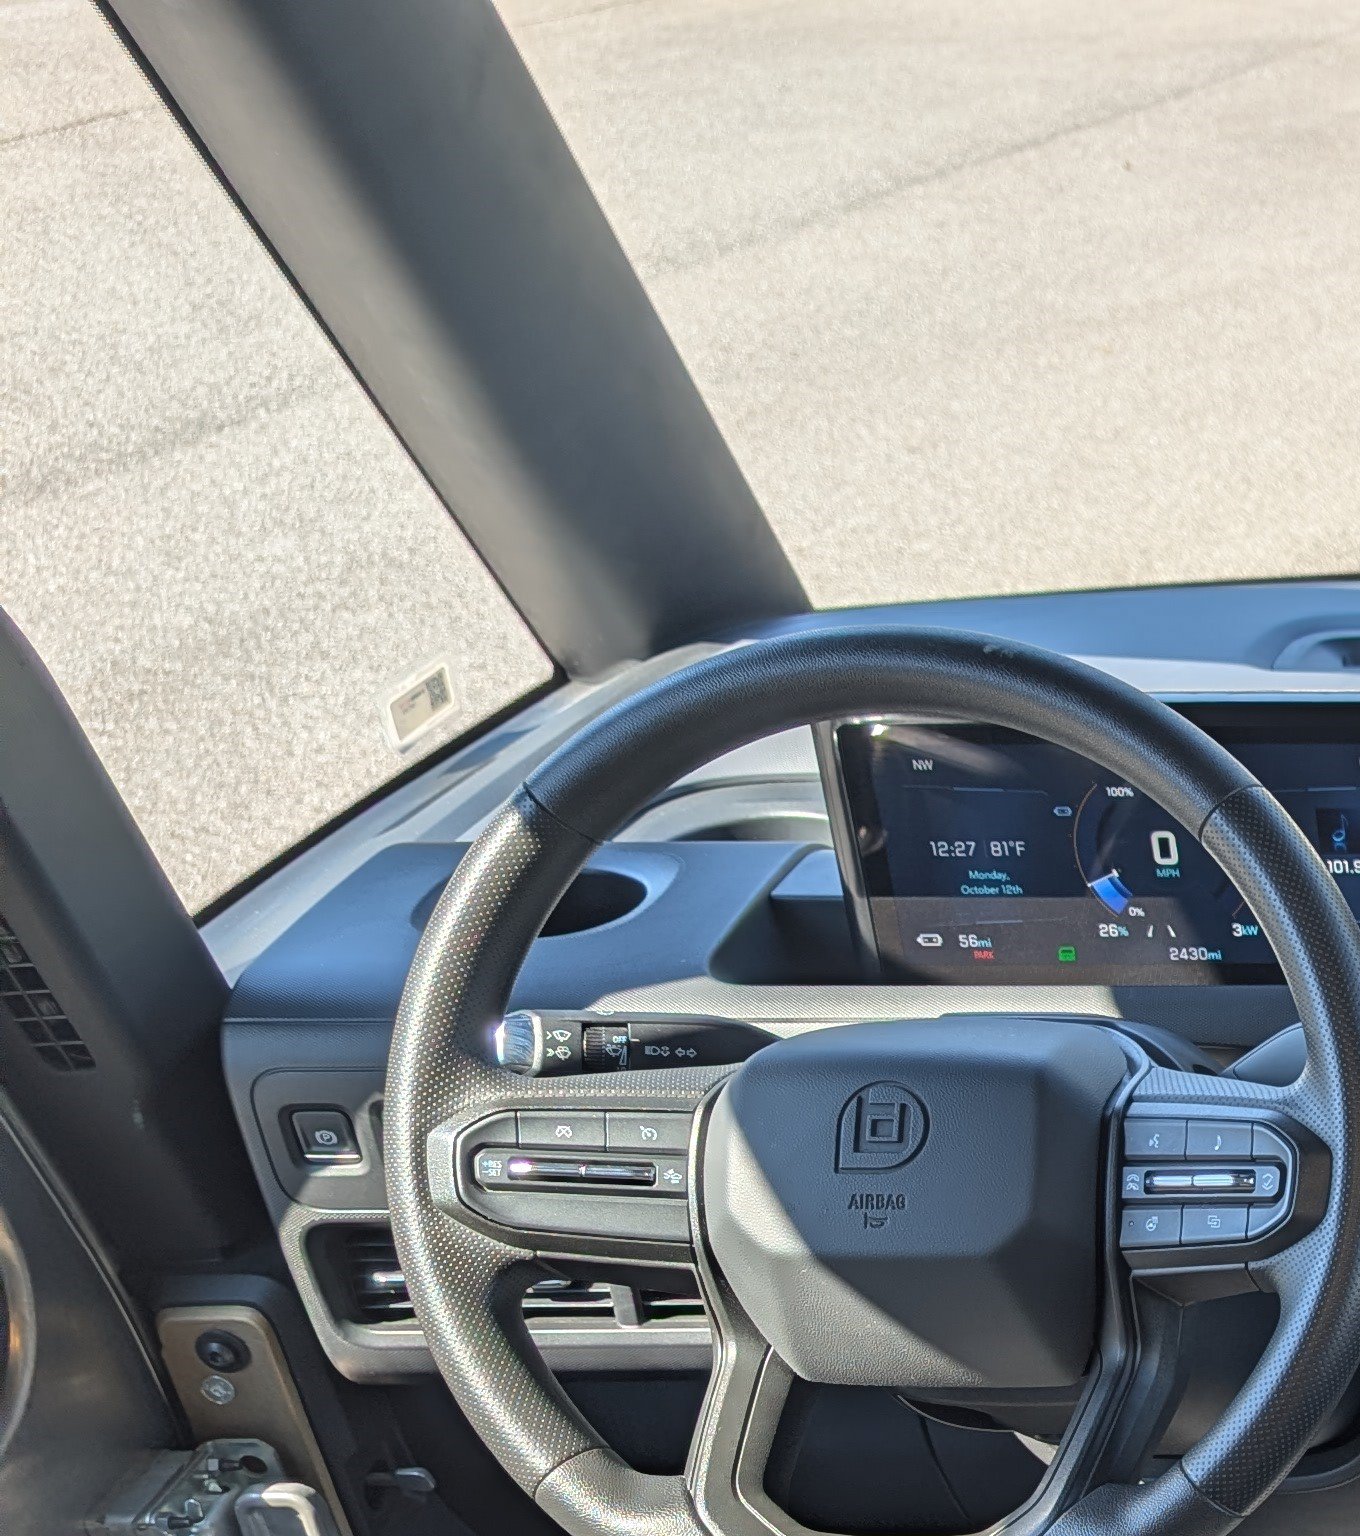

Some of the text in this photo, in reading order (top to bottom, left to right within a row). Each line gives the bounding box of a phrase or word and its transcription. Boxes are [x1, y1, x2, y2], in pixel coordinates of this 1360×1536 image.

[911, 759, 934, 771] NW
[1106, 786, 1135, 797] 100%
[930, 840, 1026, 857] 12:27 81°F
[1151, 830, 1179, 865] 0
[1156, 868, 1180, 878] MPH
[960, 885, 1024, 895] October 12th
[1128, 906, 1145, 917] 0%
[847, 1193, 906, 1210] AIRBAG
